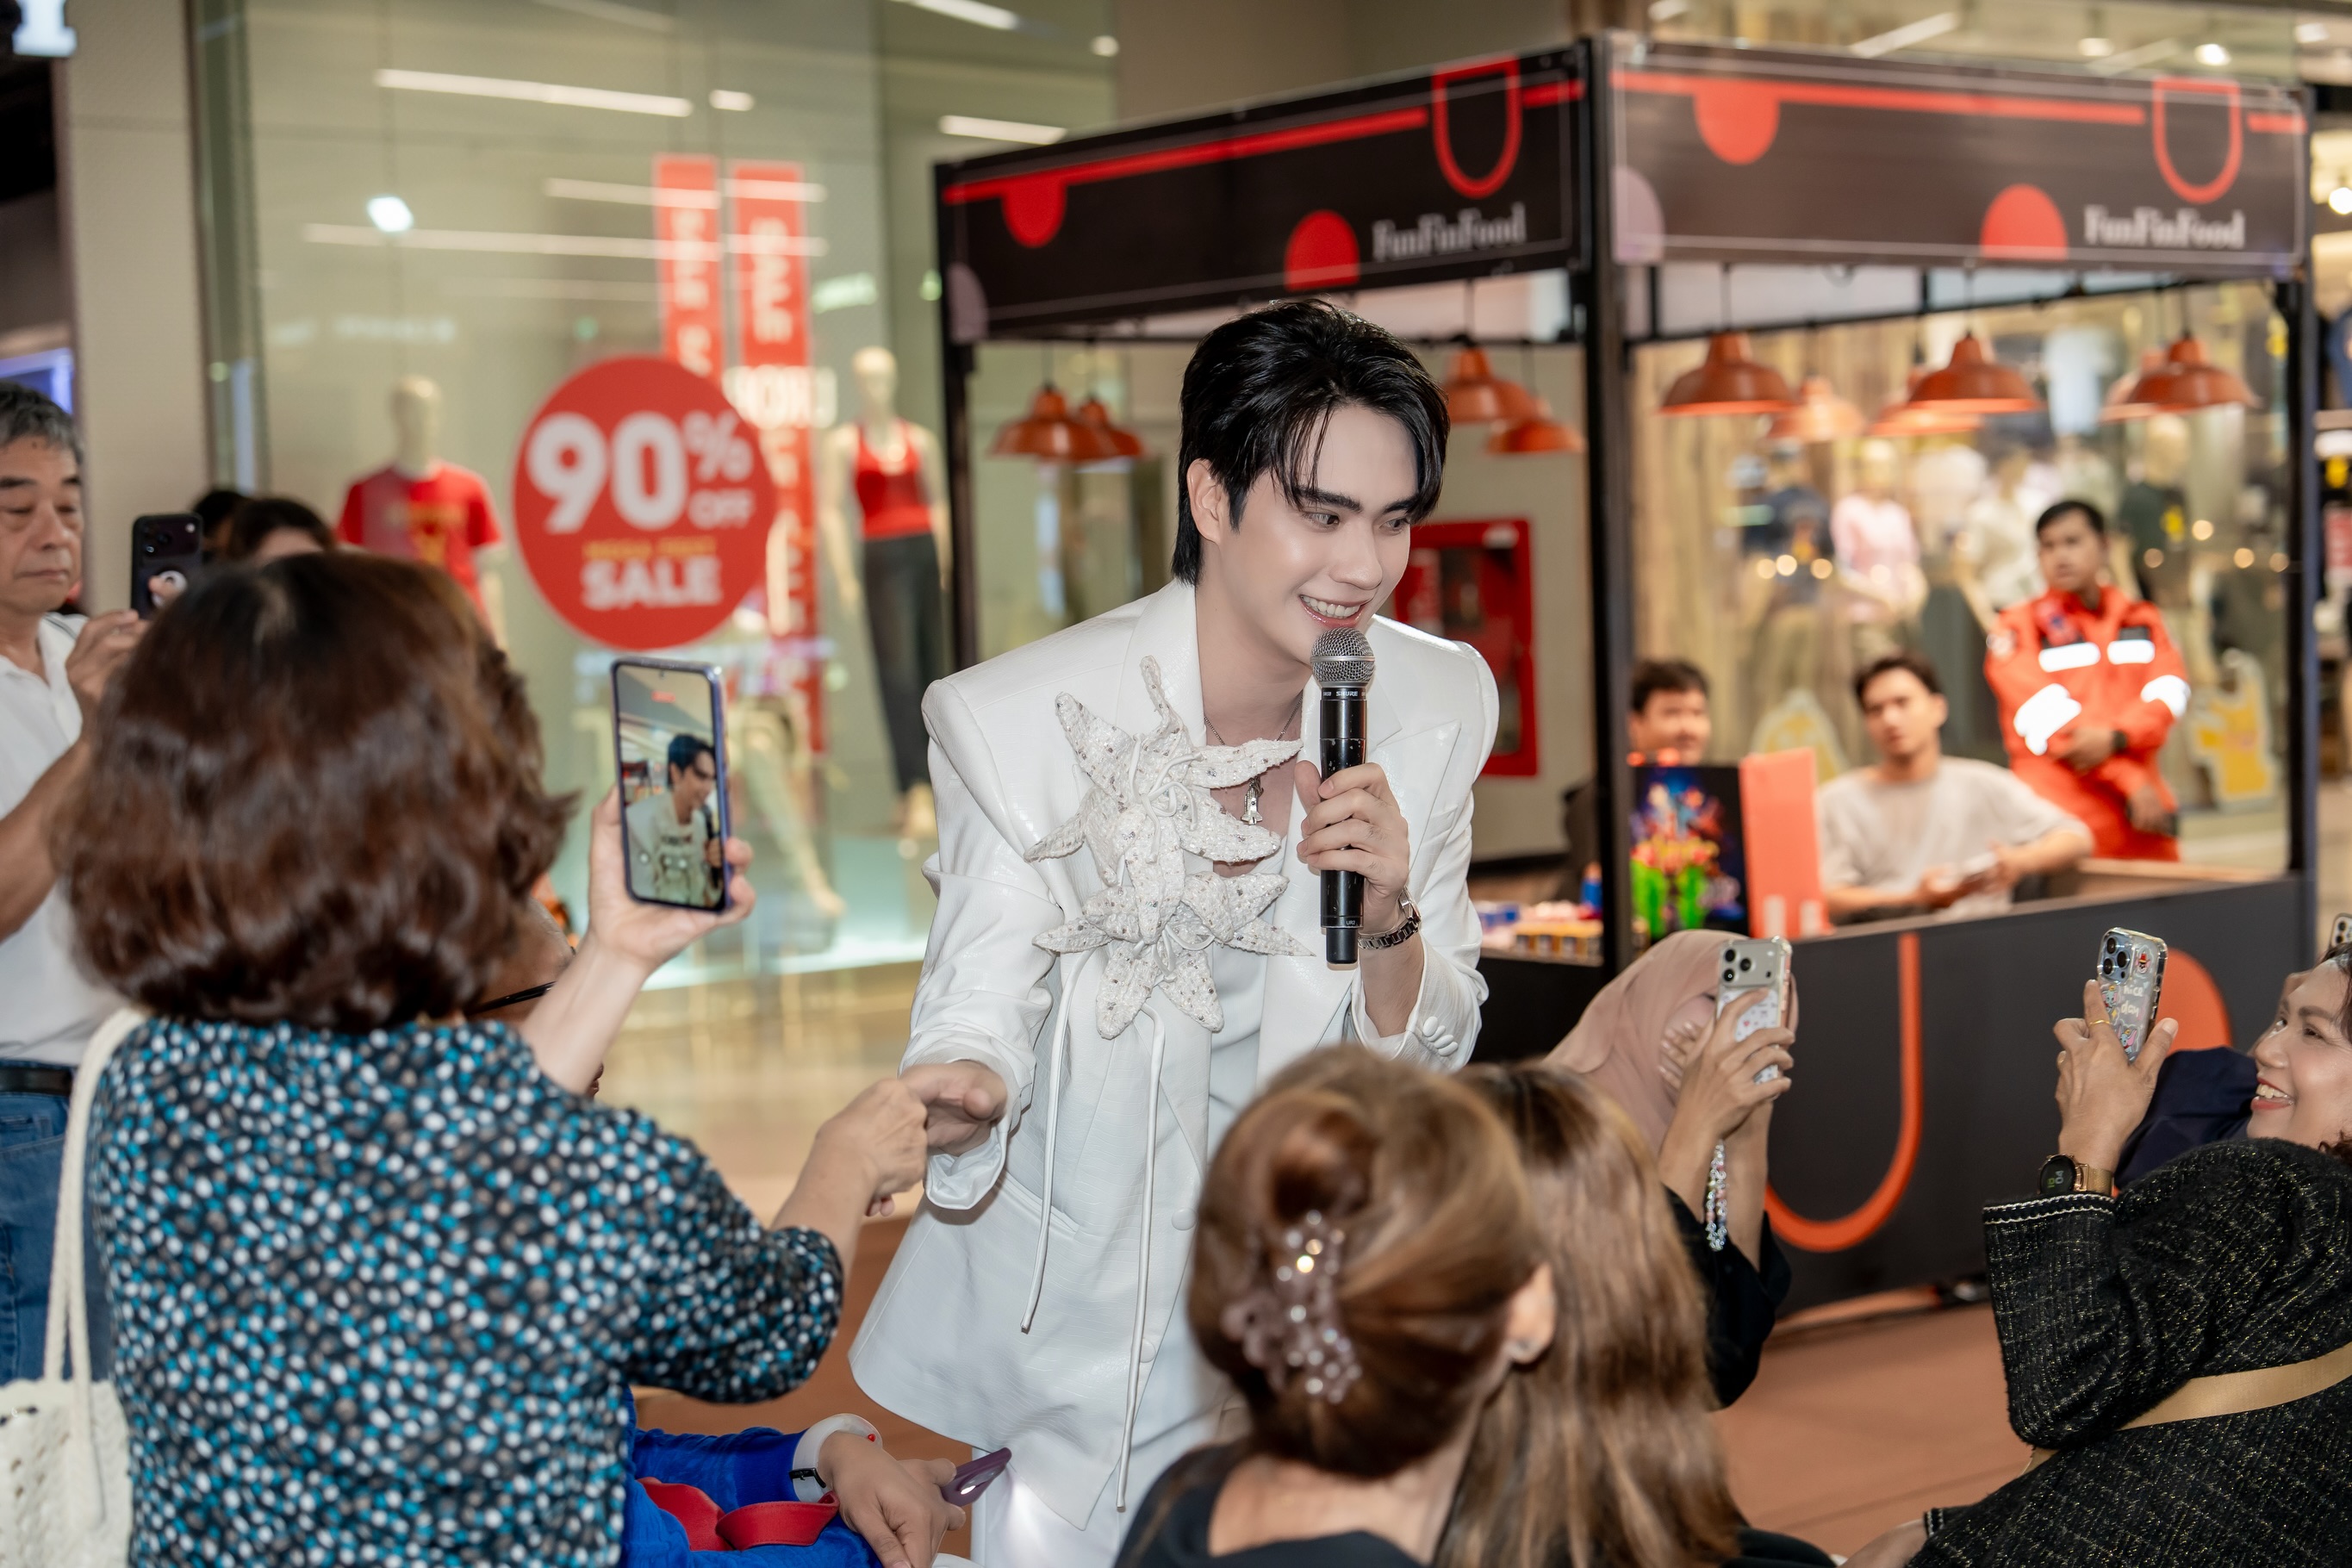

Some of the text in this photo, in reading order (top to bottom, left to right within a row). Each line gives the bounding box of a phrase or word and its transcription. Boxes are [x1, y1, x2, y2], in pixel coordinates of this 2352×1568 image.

[688, 488, 755, 531] OFF
[580, 556, 724, 611] SALE
[2123, 984, 2144, 997] nice
[2120, 999, 2139, 1017] day
